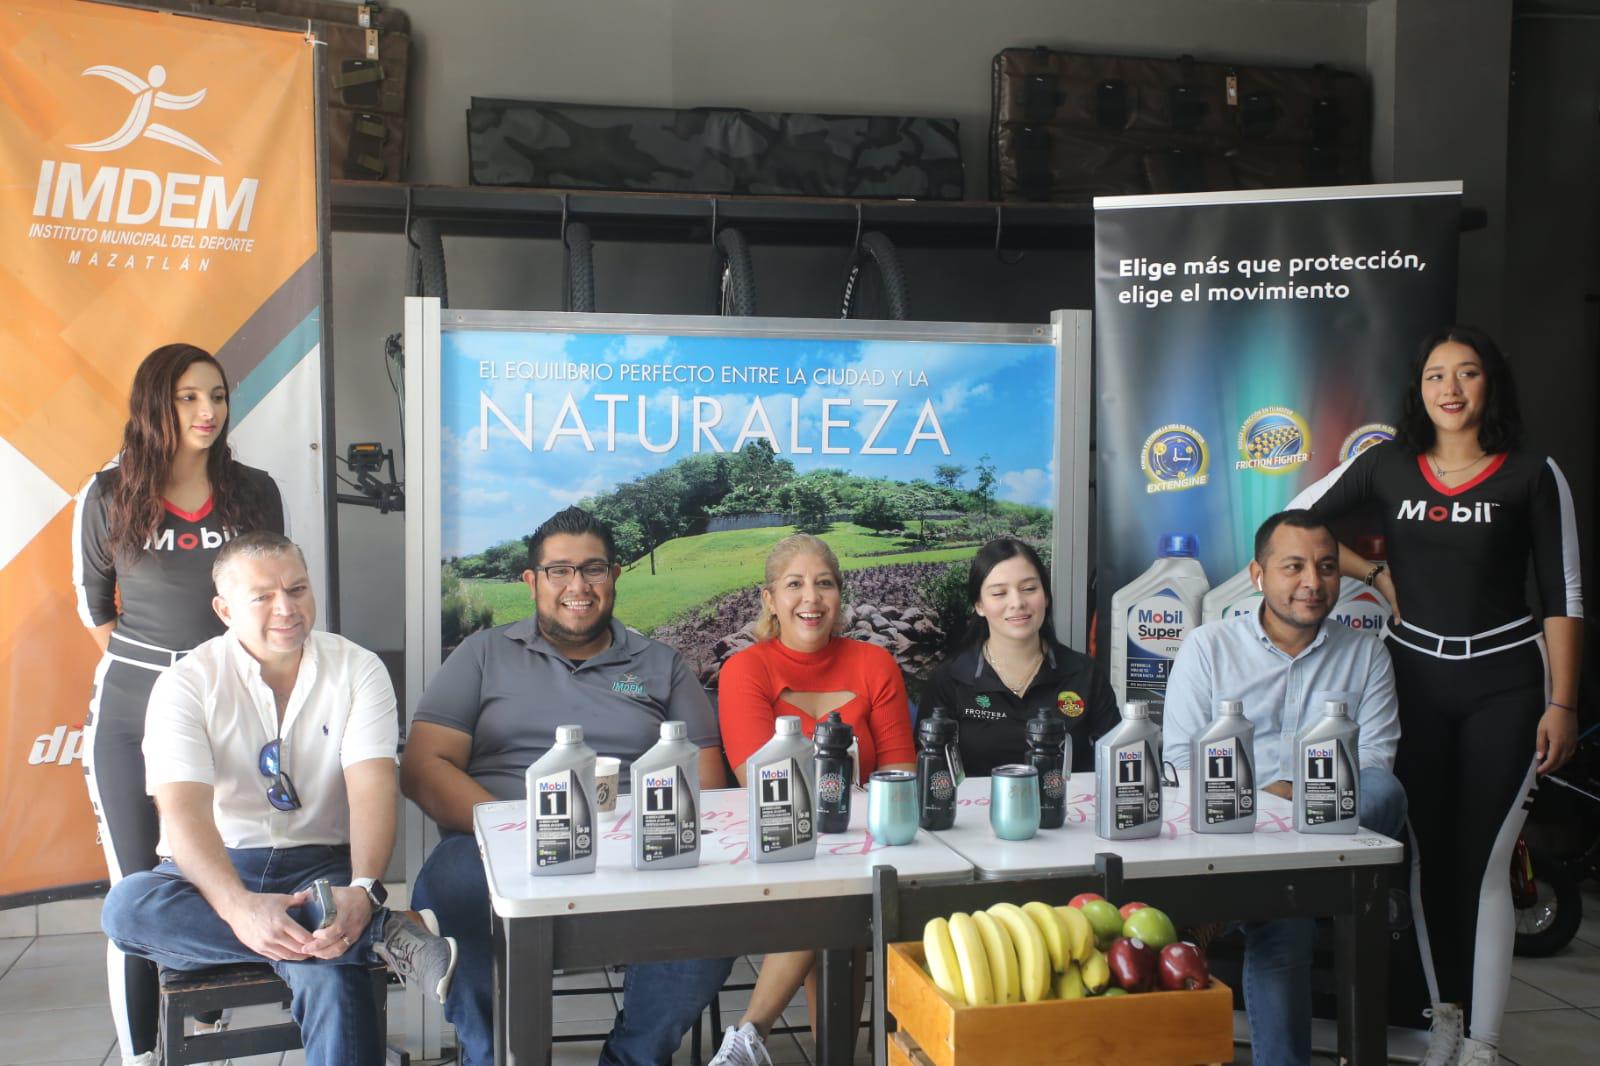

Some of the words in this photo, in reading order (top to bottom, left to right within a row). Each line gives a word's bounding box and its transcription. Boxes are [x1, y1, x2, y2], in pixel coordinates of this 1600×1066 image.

[32, 160, 259, 232] IMDEM
[29, 223, 98, 243] INSTITUTO
[100, 230, 167, 248] MUNICIPAL
[171, 235, 196, 249] DEL
[199, 235, 255, 253] DEPORTE
[68, 250, 210, 272] MAZATLÁN
[1119, 257, 1177, 281] Elige
[1184, 256, 1230, 275] más
[1237, 258, 1281, 279] que
[1289, 250, 1427, 277] protección,
[1118, 284, 1173, 308] elige
[1180, 284, 1200, 302] el
[1208, 281, 1350, 301] movimiento
[479, 361, 499, 379] EL
[505, 362, 613, 382] EQUILIBRIO
[620, 364, 714, 384] PERFECTO
[721, 366, 779, 385] ENTRE
[786, 367, 807, 385] LA
[813, 368, 885, 386] CIUDAD
[891, 369, 903, 386] Y
[909, 370, 928, 387] LA
[479, 391, 951, 456] NATURALEZA
[1235, 456, 1273, 470] FRICTION
[1273, 452, 1308, 465] FIGHTER
[1147, 475, 1207, 493] EXTENGINE
[1397, 500, 1492, 523] Mobil
[1138, 609, 1183, 624] Mobil
[1336, 614, 1382, 629] Mobil
[1138, 625, 1183, 640] Super
[1158, 663, 1164, 673] 5
[1120, 751, 1142, 760] Mobil
[1208, 748, 1233, 756] Mobil
[1308, 749, 1333, 757] Mobil
[762, 768, 788, 779] Mobil
[1126, 761, 1134, 782] 1
[1215, 758, 1224, 777] 1
[1315, 758, 1324, 778] 1
[540, 782, 567, 790] Mobil
[647, 777, 672, 786] Mobil
[769, 780, 780, 801] 1
[547, 792, 557, 815] 1
[654, 788, 664, 811] 1
